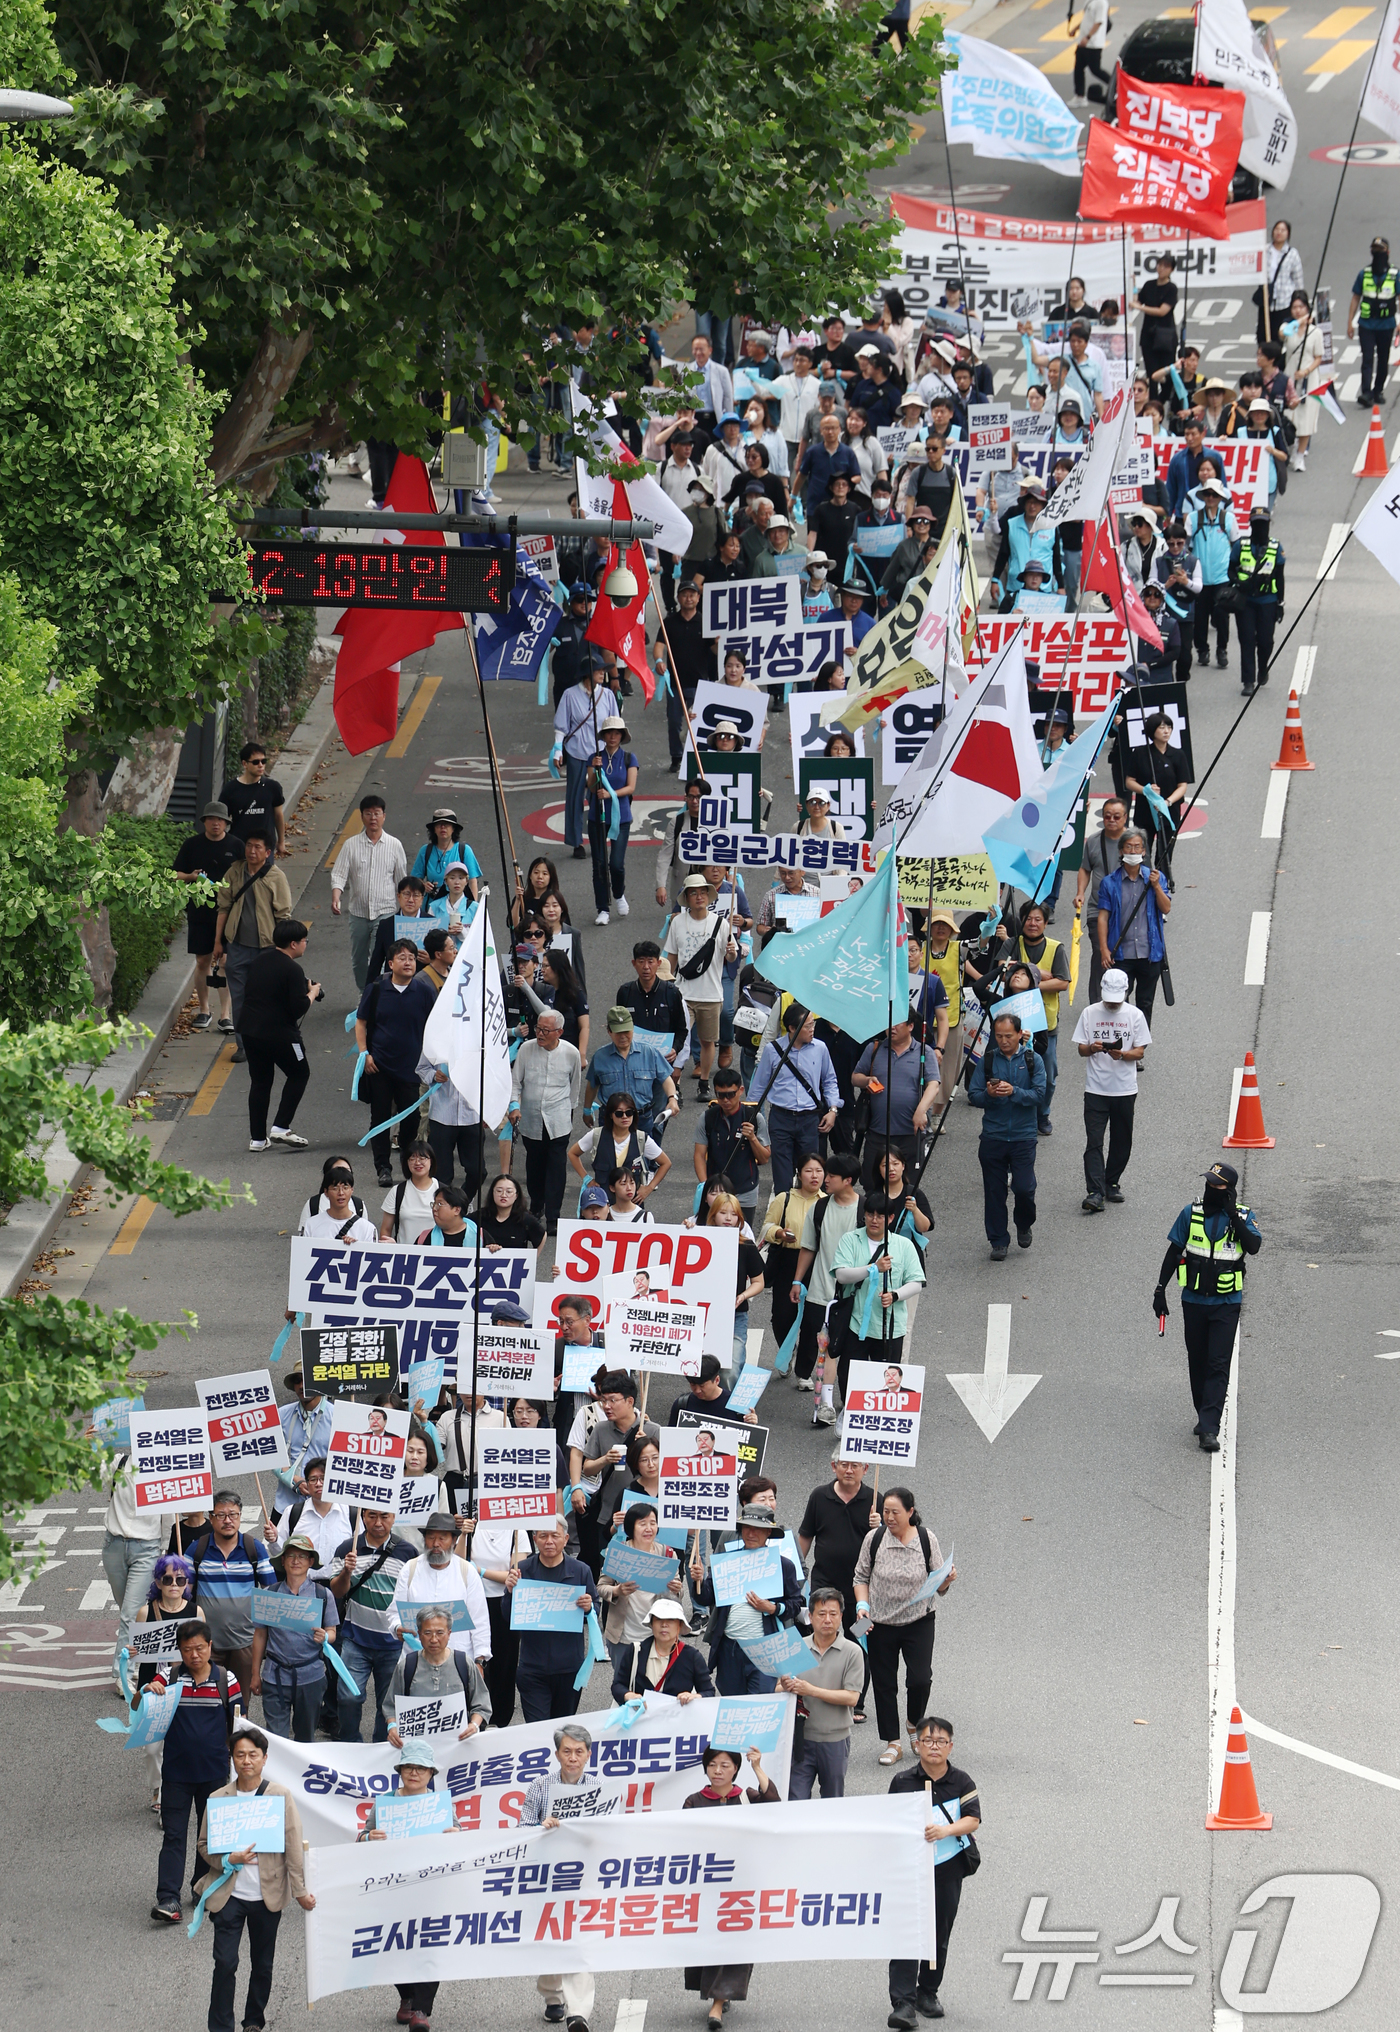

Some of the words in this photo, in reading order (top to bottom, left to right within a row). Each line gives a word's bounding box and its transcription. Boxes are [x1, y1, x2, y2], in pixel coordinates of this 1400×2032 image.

[1125, 90, 1223, 149] 진보당
[1111, 143, 1213, 201] 진보당
[971, 413, 1009, 427] 전쟁조장
[976, 429, 1004, 446] STOP
[975, 447, 1007, 462] 윤석열
[710, 582, 789, 632] 대북
[702, 798, 728, 827] 미
[1093, 1030, 1109, 1040] 조선
[565, 1228, 713, 1287] STOP
[305, 1247, 530, 1314] 전쟁조장
[626, 1307, 669, 1324] 전쟁나면
[670, 1312, 697, 1327] 공멸!
[319, 1331, 348, 1348] 긴장
[350, 1329, 385, 1347] 격화!
[620, 1322, 666, 1339] 9.19합의
[668, 1327, 692, 1342] 폐기
[319, 1347, 348, 1363] 충돌
[350, 1345, 385, 1362] 조장!
[629, 1338, 682, 1357] 규탄한다
[312, 1364, 357, 1382] 윤석열
[359, 1362, 391, 1379] 규탄
[477, 1364, 533, 1381] 중단하라!
[205, 1386, 270, 1411] 전쟁조장
[863, 1391, 910, 1411] STOP
[220, 1409, 268, 1438] STOP
[849, 1413, 913, 1435] 전쟁조장
[137, 1427, 204, 1449] 윤석열은
[222, 1435, 278, 1461] 윤석열
[346, 1434, 393, 1456] STOP
[846, 1437, 911, 1459] 대북전단
[138, 1452, 206, 1474] 전쟁도발
[331, 1455, 397, 1480] 전쟁조장
[483, 1448, 551, 1465] 윤석열은
[677, 1456, 724, 1477] STOP
[144, 1475, 205, 1503] 멈춰라!
[327, 1479, 393, 1504] 대북전단
[483, 1472, 551, 1489] 전쟁도발
[664, 1480, 731, 1499] 전쟁조장
[488, 1495, 549, 1518] 멈춰라!
[663, 1504, 730, 1522] 대북전단
[608, 1546, 670, 1568] 대북전단
[712, 1549, 770, 1579] 대북전단
[716, 1560, 778, 1589] 확성기방송
[253, 1593, 313, 1611] 대북전단
[514, 1585, 576, 1602] 대북전단
[717, 1584, 745, 1600] 중단!
[513, 1611, 542, 1625] 중단!
[133, 1621, 178, 1645] 전쟁조장
[399, 1700, 443, 1723] 전쟁조장
[720, 1703, 780, 1725] 대북전단
[398, 1722, 426, 1738] 윤석열
[427, 1709, 465, 1735] 규탄!
[716, 1715, 781, 1738] 확성기방송
[714, 1734, 747, 1747] 중단!
[446, 1747, 552, 1798] 탈출용
[378, 1793, 442, 1822] 대북전단
[552, 1787, 602, 1811] 전쟁조장
[209, 1797, 273, 1824] 대북전단
[210, 1813, 281, 1837] 확성기방송
[209, 1831, 241, 1849] 중단!
[482, 1859, 586, 1897] 국민을
[597, 1852, 736, 1890] 위협하는
[351, 1909, 523, 1959] 군사분계선
[533, 1892, 701, 1942] 사격훈련
[716, 1888, 883, 1933] 중단하라!
